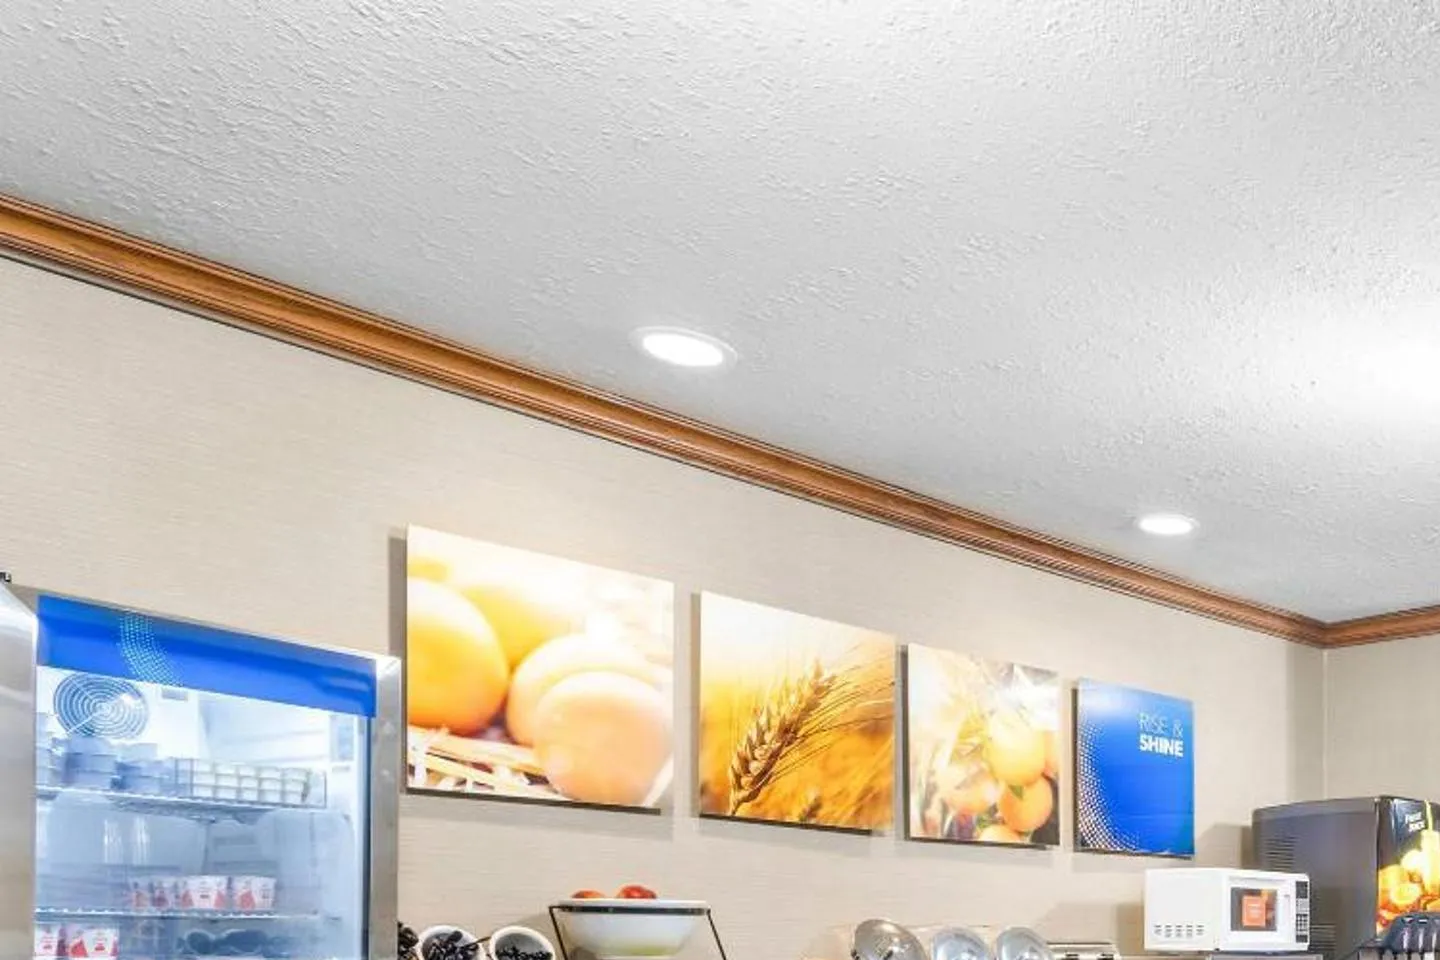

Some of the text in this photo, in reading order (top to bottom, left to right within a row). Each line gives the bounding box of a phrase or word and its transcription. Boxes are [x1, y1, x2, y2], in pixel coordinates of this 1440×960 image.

[1139, 711, 1183, 738] RISE &
[1139, 734, 1184, 758] SHINE
